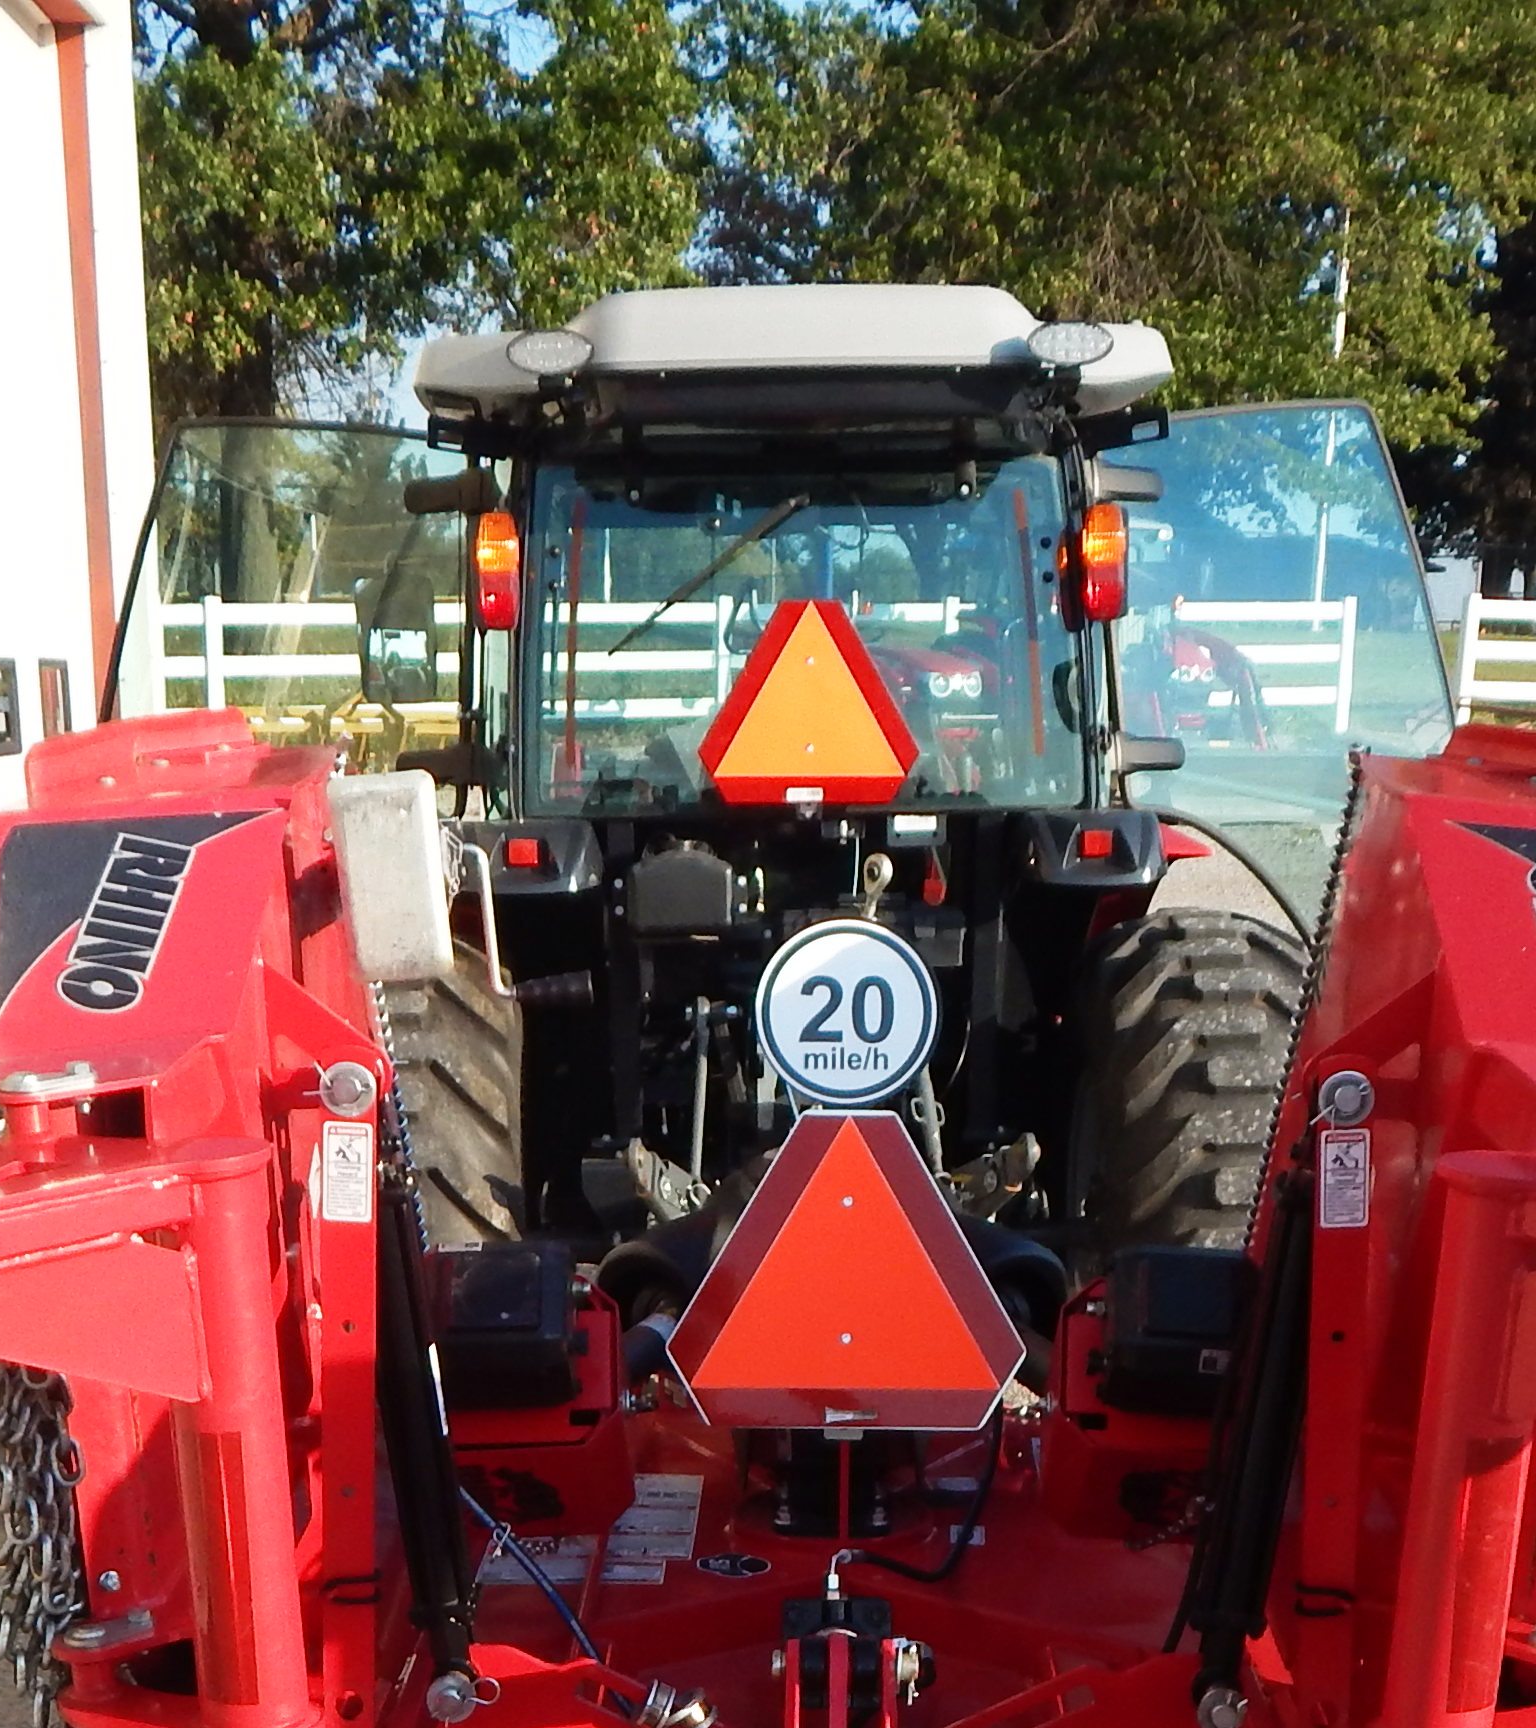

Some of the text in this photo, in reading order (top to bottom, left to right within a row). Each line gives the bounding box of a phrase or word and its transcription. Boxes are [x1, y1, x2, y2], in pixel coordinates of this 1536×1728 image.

[57, 832, 196, 1013] RHINO
[799, 975, 894, 1043] 20
[804, 1046, 888, 1070] mile/h
